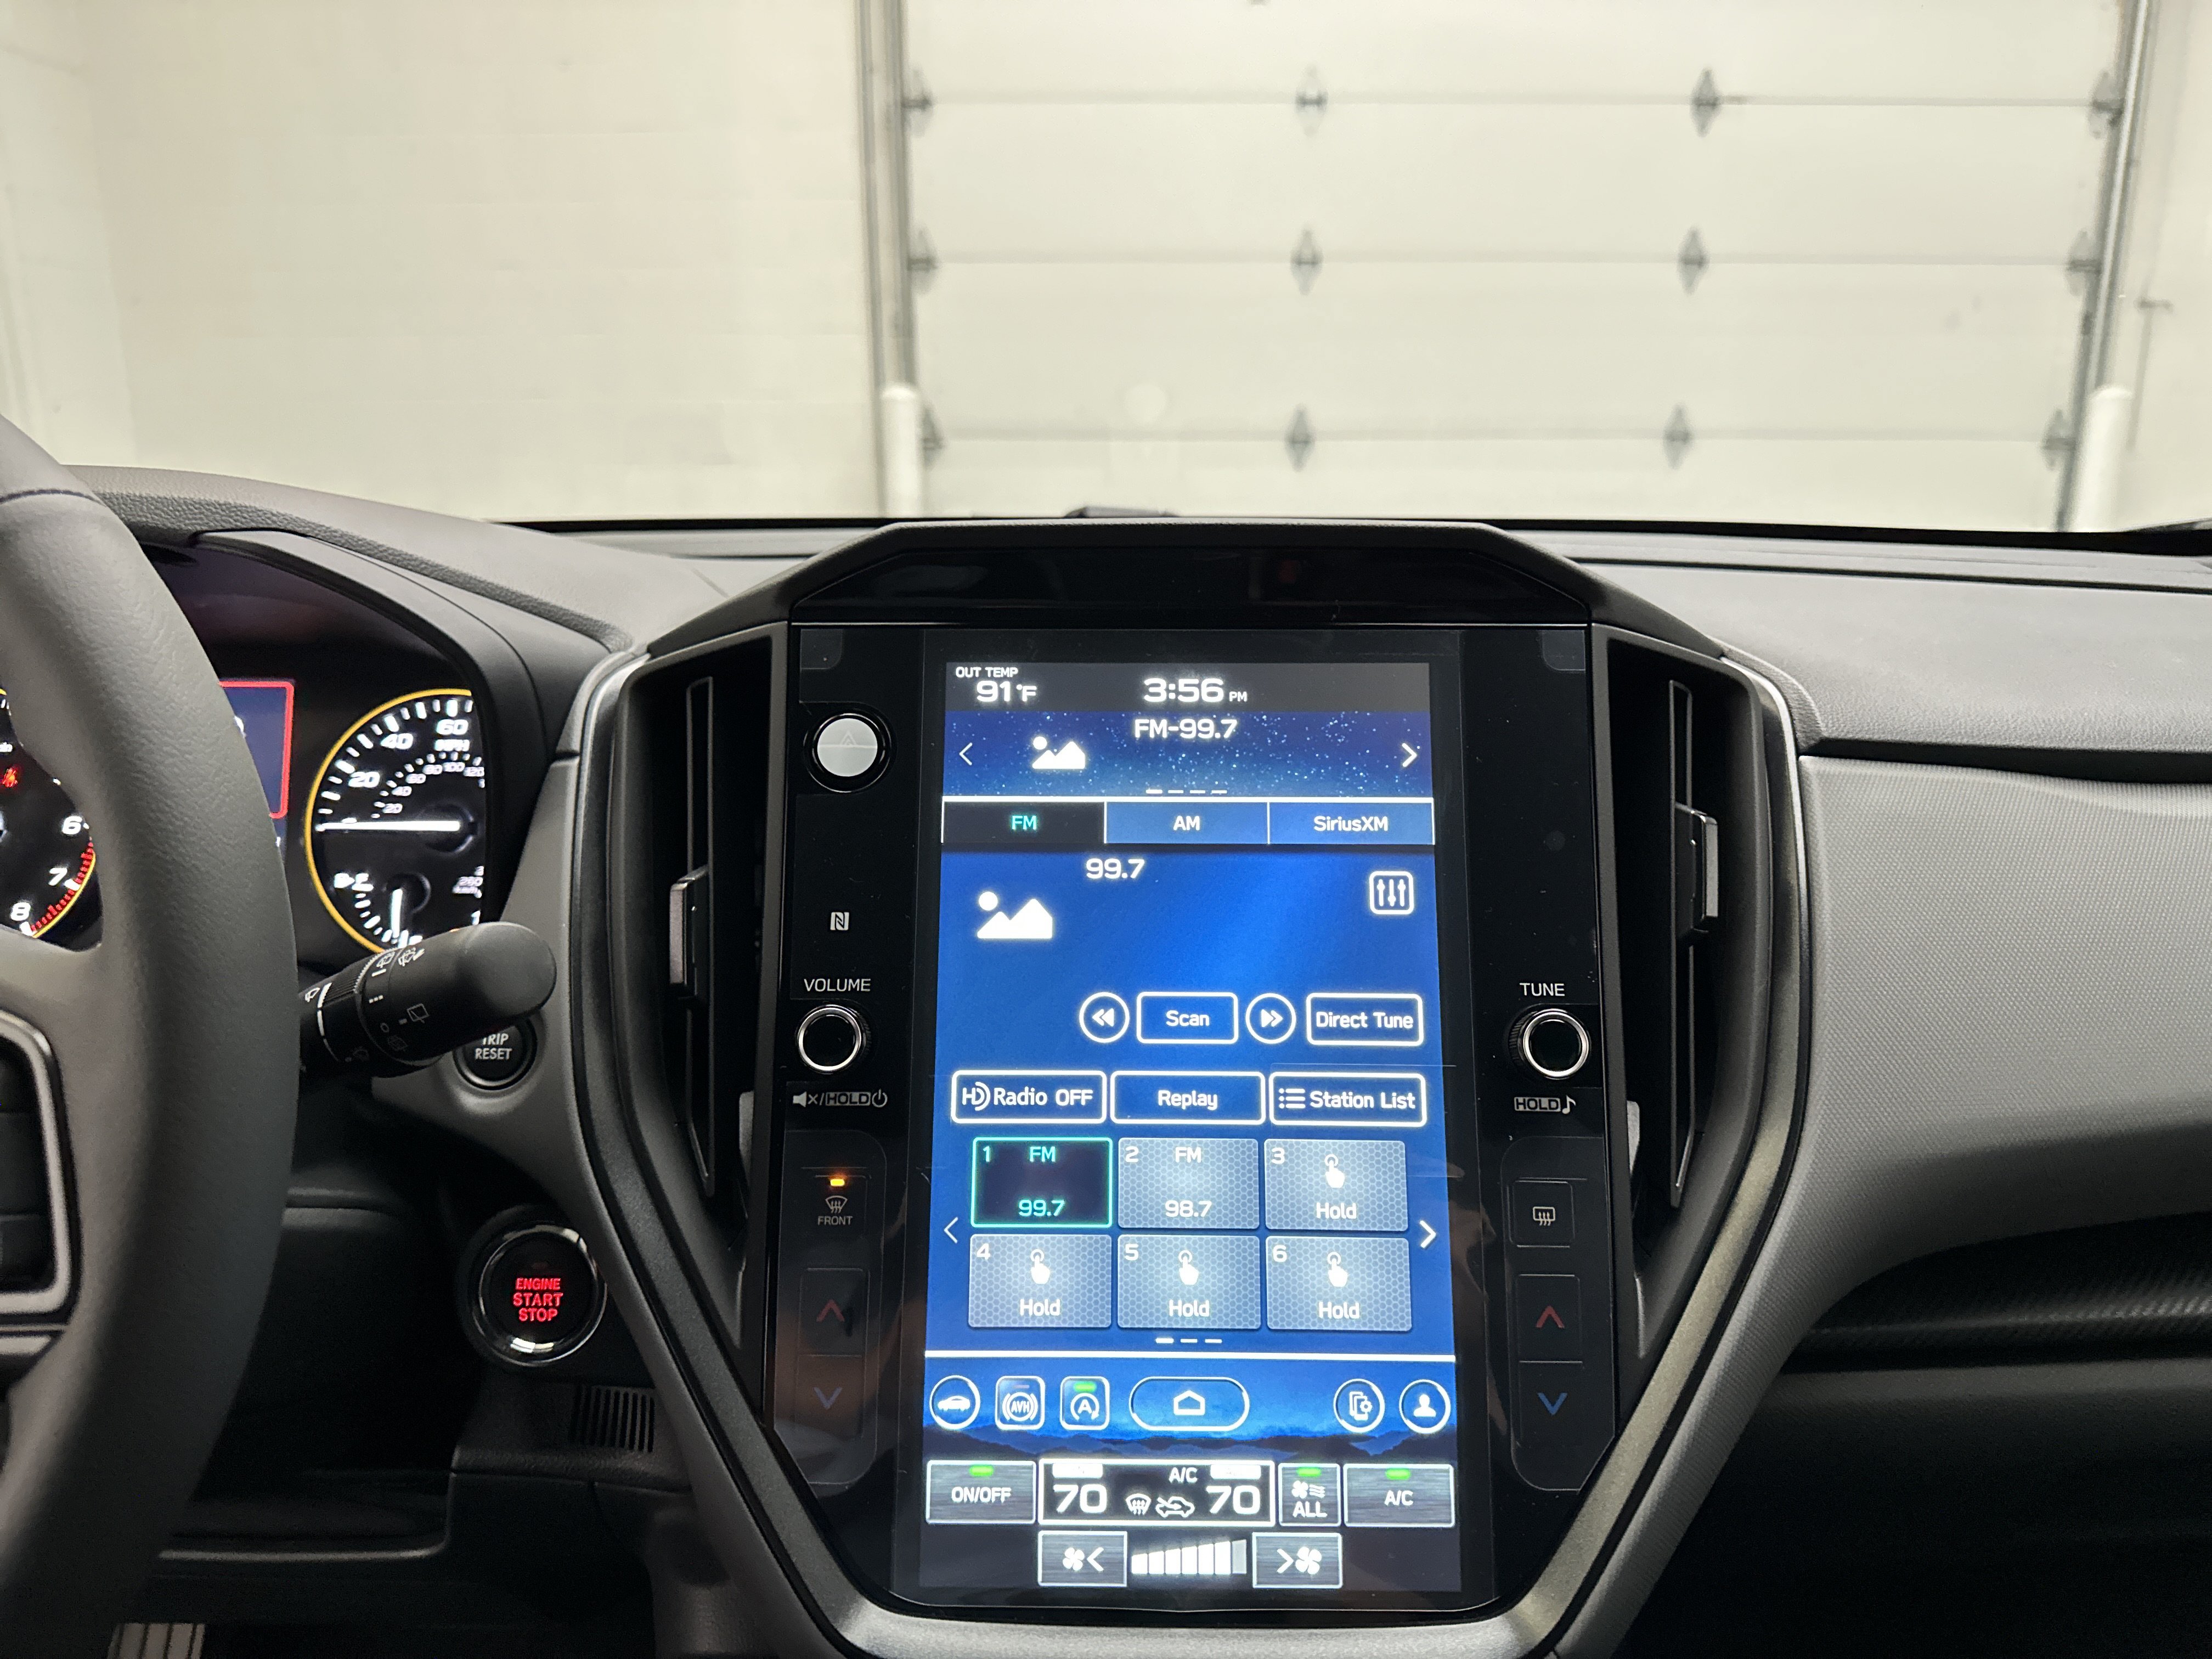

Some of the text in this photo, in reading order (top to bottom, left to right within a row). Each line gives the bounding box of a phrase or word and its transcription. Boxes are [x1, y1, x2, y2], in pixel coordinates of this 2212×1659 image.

[955, 666, 1019, 678] OUT TEMP
[1143, 677, 1248, 703] 3:56 PM
[436, 719, 469, 736] 60
[1135, 718, 1238, 740] FM-99.7
[380, 732, 414, 750] 40
[347, 771, 381, 788] 20
[61, 815, 83, 835] 6
[1011, 815, 1037, 831] FM
[1173, 815, 1200, 831] AM
[1313, 815, 1389, 832] SiriusXM
[48, 867, 67, 886] 7
[1085, 857, 1146, 879] 99.7
[10, 901, 31, 921] 8
[804, 978, 871, 992] VOLUME
[1519, 983, 1565, 996] TUNE
[1166, 1009, 1210, 1026] Scan
[1316, 1011, 1414, 1029] Direct Tune
[475, 1047, 512, 1060] RESET
[827, 1093, 870, 1105] HOLD
[994, 1086, 1048, 1105] Radio
[1055, 1088, 1093, 1107] OFF
[1158, 1090, 1218, 1111] Replay
[1310, 1090, 1416, 1109] Station List
[1516, 1098, 1559, 1110] HOLD
[981, 1146, 992, 1163] 1
[1029, 1146, 1057, 1163] FM
[1124, 1146, 1139, 1163] 2
[1175, 1146, 1201, 1163] FM
[1269, 1144, 1287, 1165] 3
[1018, 1199, 1065, 1217] 99.7
[1165, 1198, 1212, 1217] 98.7
[1316, 1201, 1357, 1220] Hold
[817, 1215, 853, 1226] FRONT
[976, 1243, 991, 1260] 4
[1124, 1240, 1139, 1261] 5
[1271, 1244, 1288, 1263] 6
[515, 1278, 561, 1291] ENGINE
[513, 1291, 563, 1307] START
[1019, 1297, 1061, 1318] Hold
[1169, 1297, 1211, 1317] Hold
[518, 1307, 558, 1322] STOP
[1318, 1300, 1360, 1319] Hold
[1011, 1400, 1030, 1414] AVH
[1077, 1399, 1092, 1414] A
[1169, 1466, 1198, 1483] A/C
[951, 1486, 1012, 1503] ON/OFF
[1053, 1483, 1108, 1514] 70
[1205, 1485, 1261, 1515] 70
[1384, 1489, 1414, 1506] A/C
[1293, 1500, 1328, 1518] ALL
